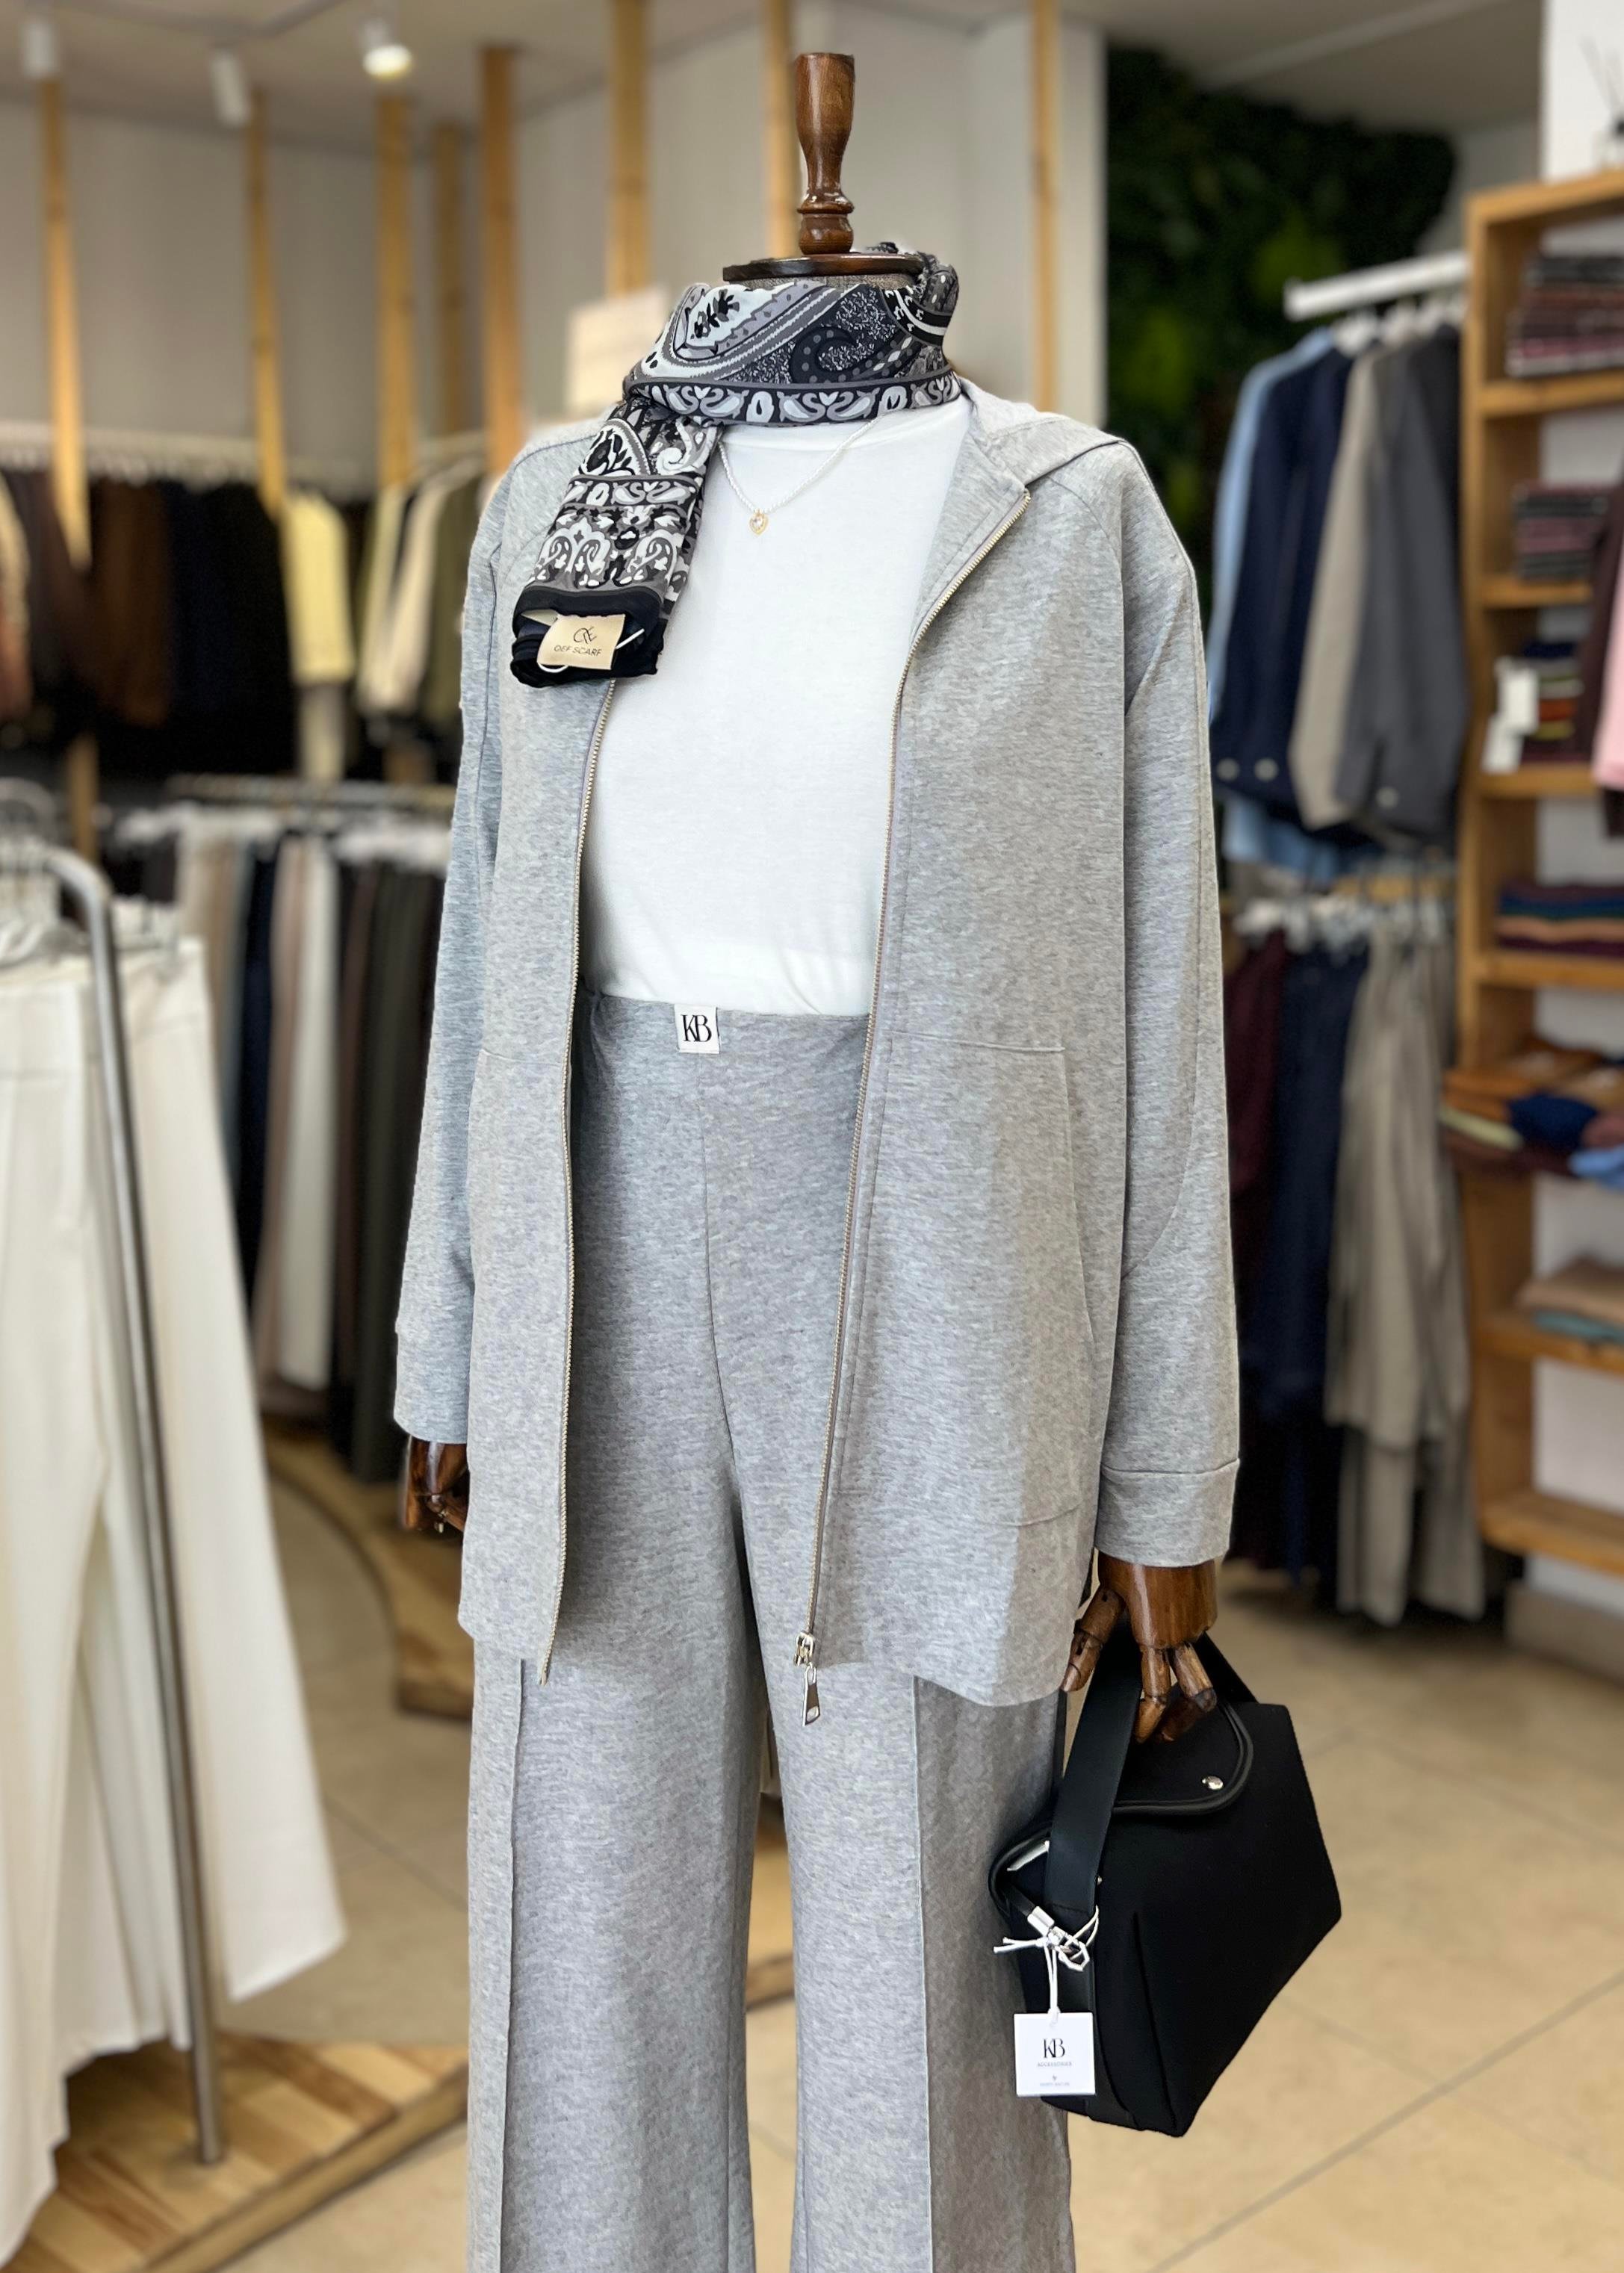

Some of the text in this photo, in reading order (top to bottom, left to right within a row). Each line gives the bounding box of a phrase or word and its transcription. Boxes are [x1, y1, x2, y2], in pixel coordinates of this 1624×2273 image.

[572, 646, 602, 657] SCARF
[681, 1014, 712, 1042] KB
[1043, 2038, 1066, 2059] KB
